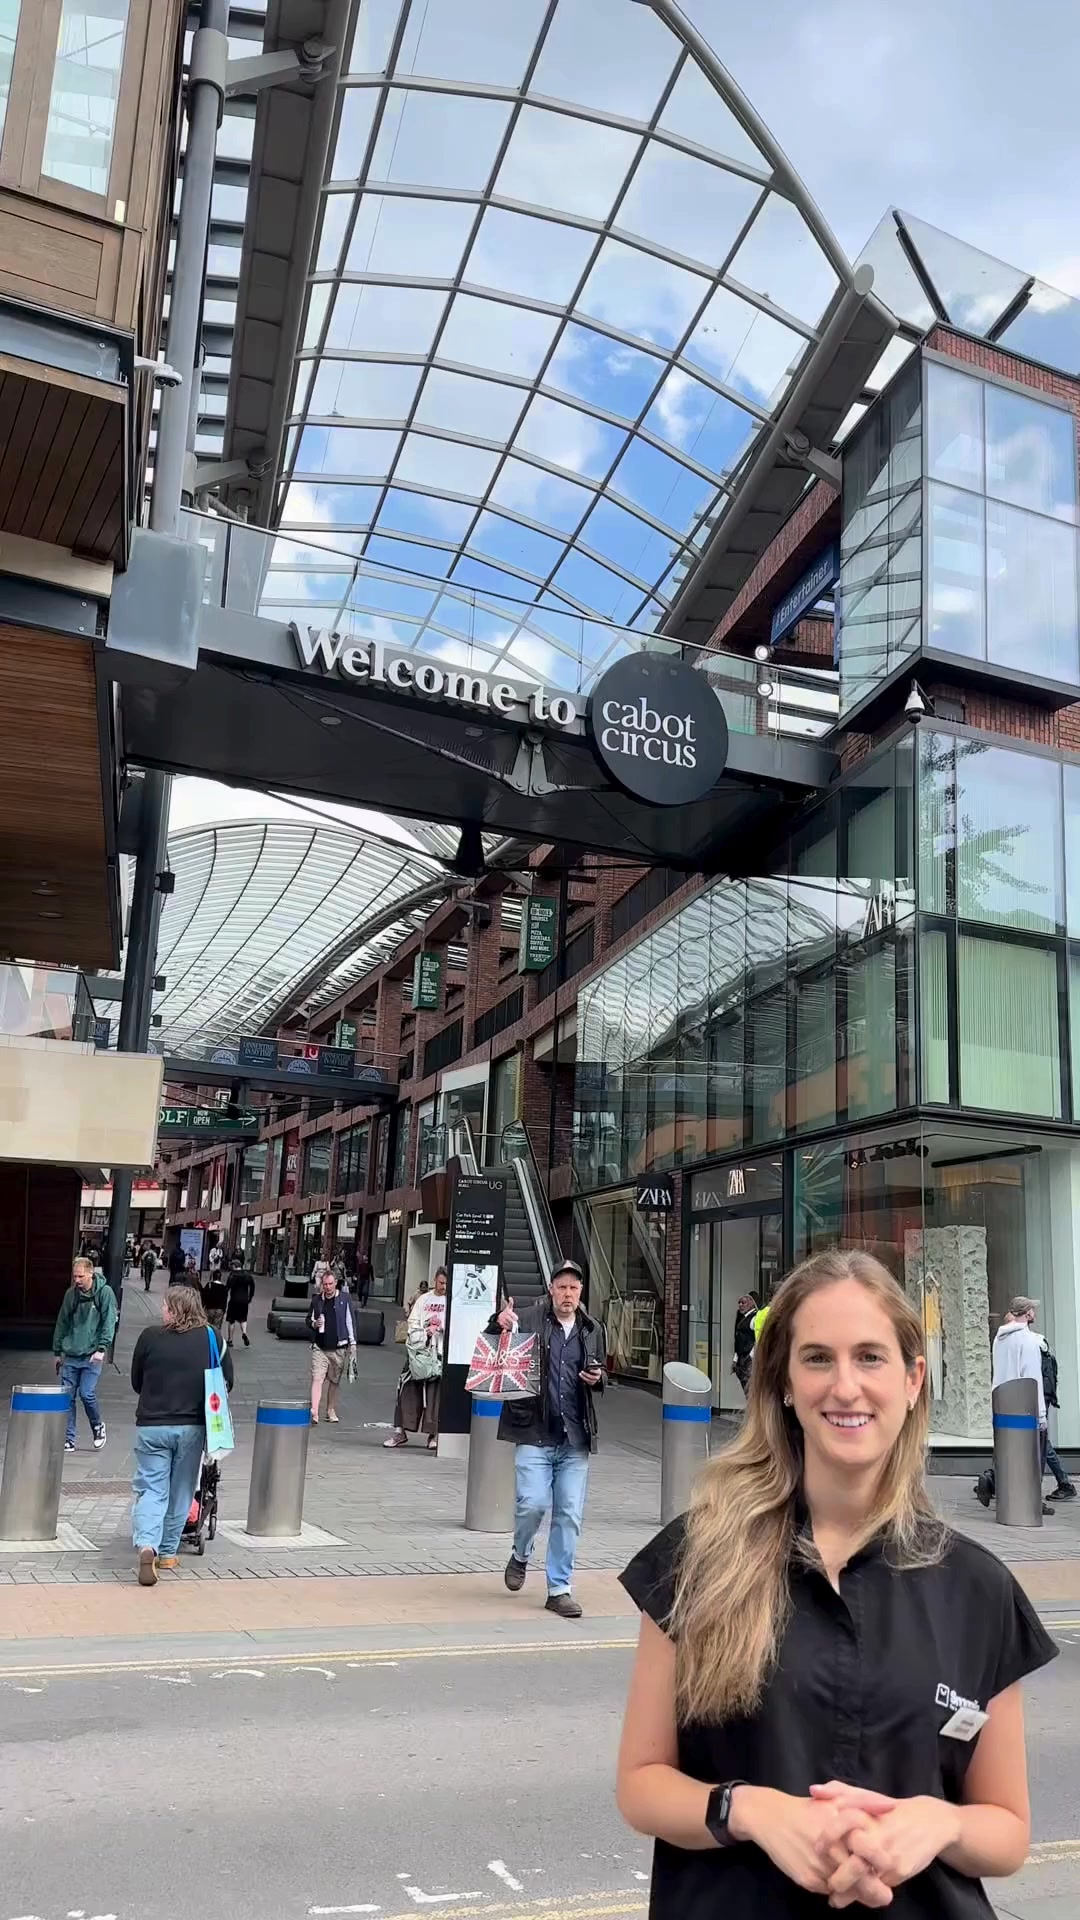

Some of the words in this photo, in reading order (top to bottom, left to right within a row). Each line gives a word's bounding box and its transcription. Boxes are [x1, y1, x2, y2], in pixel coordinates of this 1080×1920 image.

[780, 560, 828, 622] Entertainer
[290, 621, 517, 713] Welcome
[531, 685, 577, 727] to
[602, 696, 696, 743] cabot
[601, 727, 697, 769] circus
[193, 1116, 211, 1125] OPEN
[489, 1181, 503, 1190] UG
[729, 1169, 745, 1195] ZARA
[637, 1187, 672, 1206] ZARA
[485, 1350, 520, 1368] M&S
